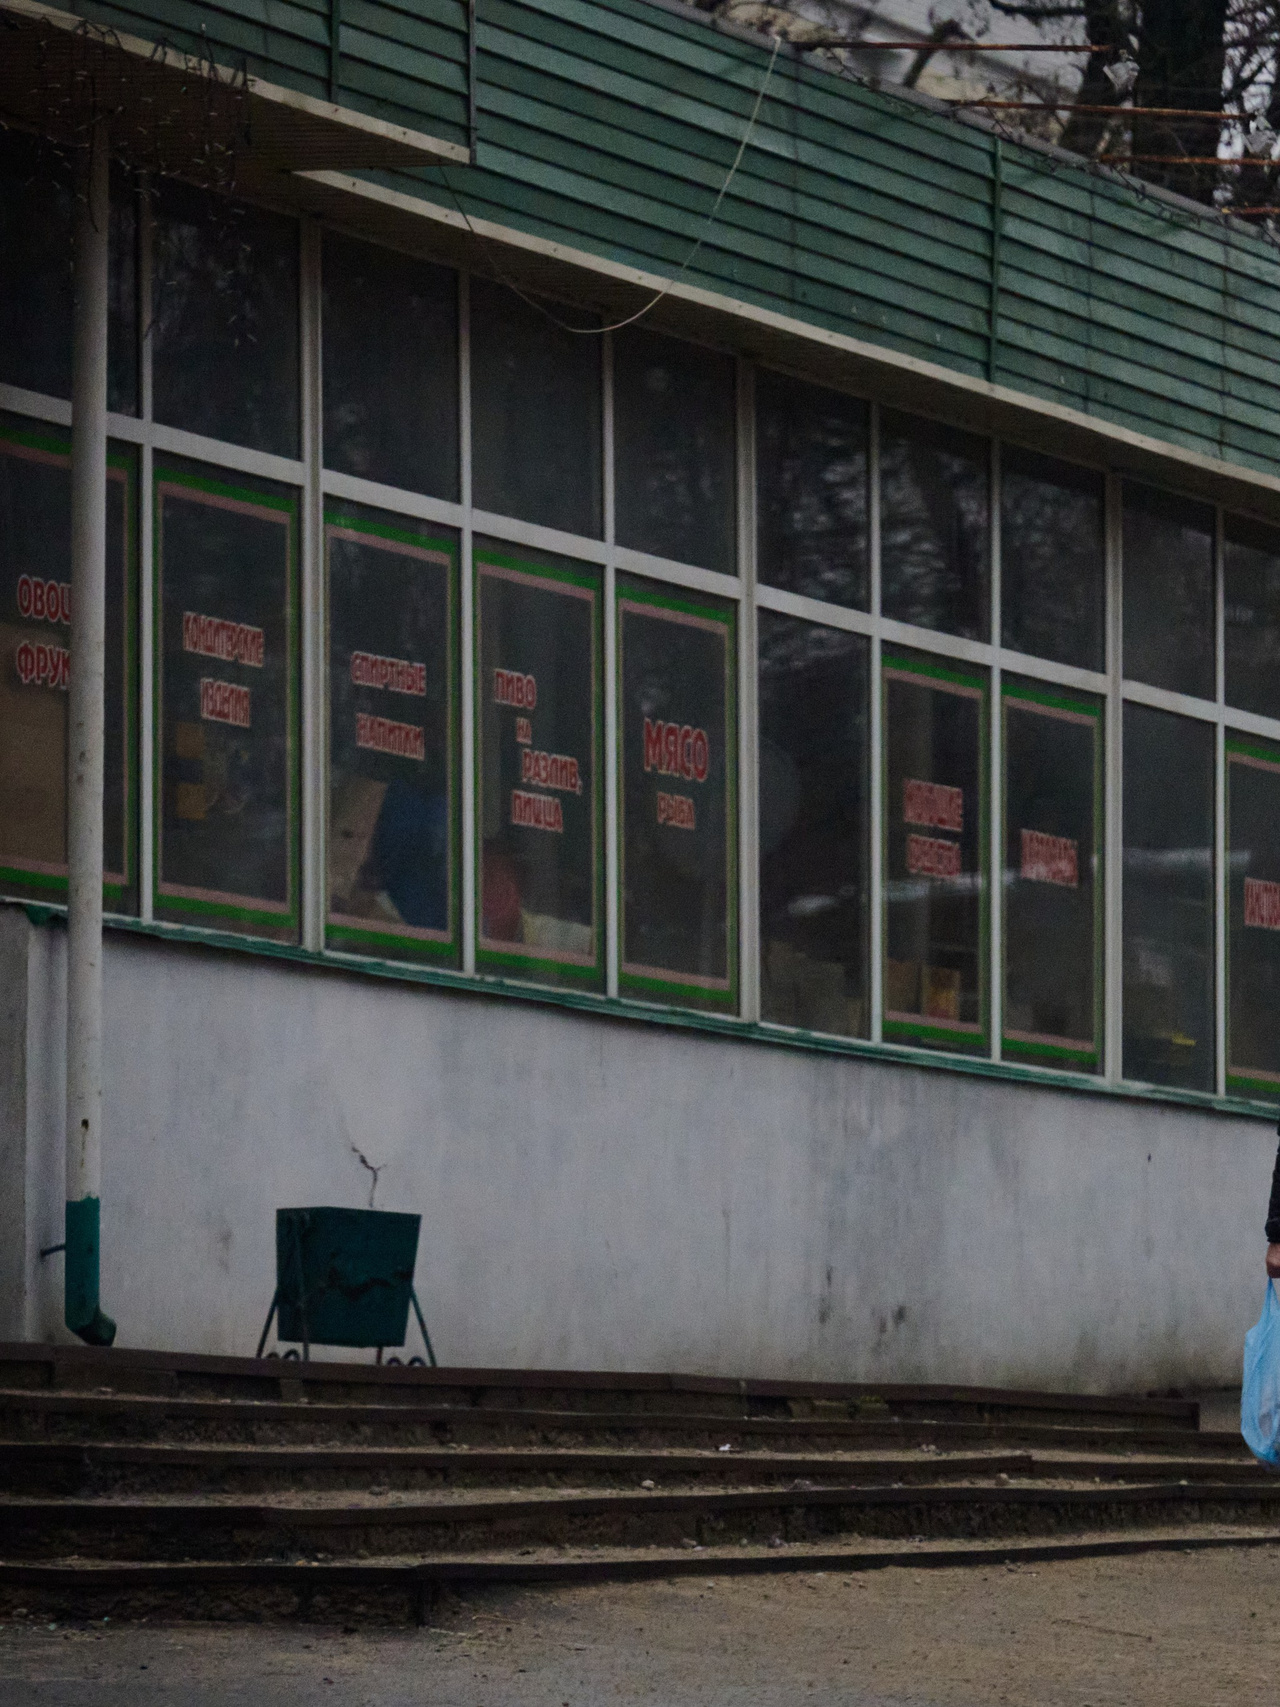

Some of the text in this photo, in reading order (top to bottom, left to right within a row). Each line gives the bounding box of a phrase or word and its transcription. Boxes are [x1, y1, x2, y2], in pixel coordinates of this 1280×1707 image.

[352, 650, 427, 697] СПИРТНЫЕ
[494, 668, 537, 710] ПИВО
[355, 712, 425, 761] НАПИТКИ
[516, 717, 532, 745] НА
[643, 716, 711, 782] МЯСО
[511, 789, 563, 834] ПИЦЦА
[657, 791, 696, 831] РЫБА
